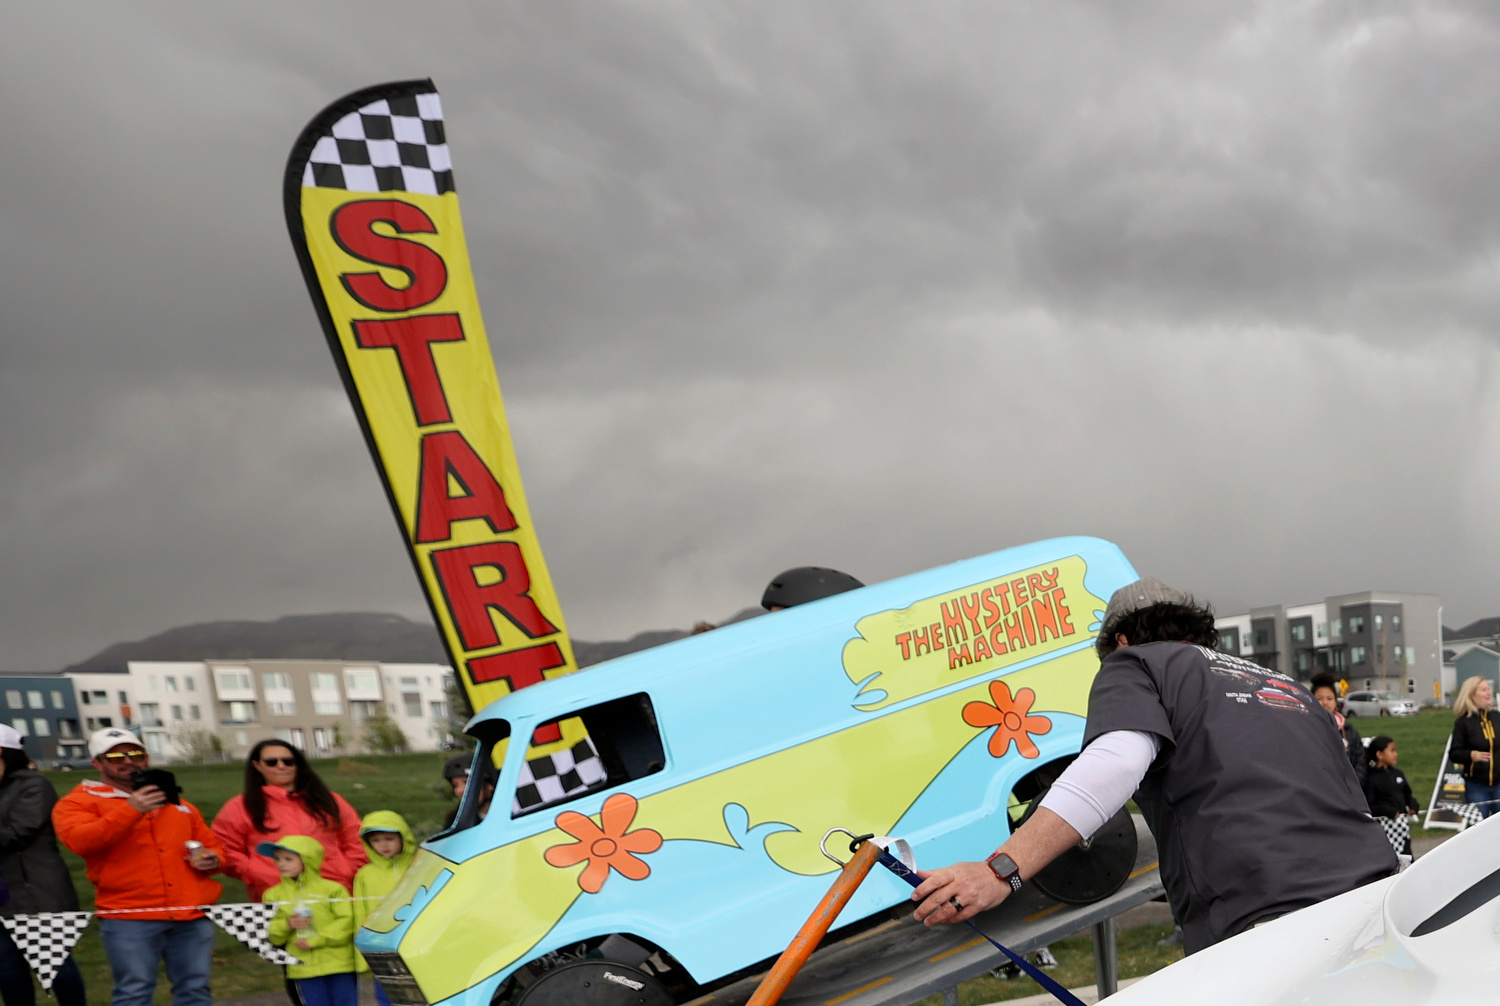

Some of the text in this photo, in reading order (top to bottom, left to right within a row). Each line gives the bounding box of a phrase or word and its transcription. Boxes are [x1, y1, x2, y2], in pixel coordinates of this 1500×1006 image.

[329, 198, 566, 747] START
[895, 567, 1059, 660] THE MYSTERY
[948, 587, 1075, 670] MACHINE
